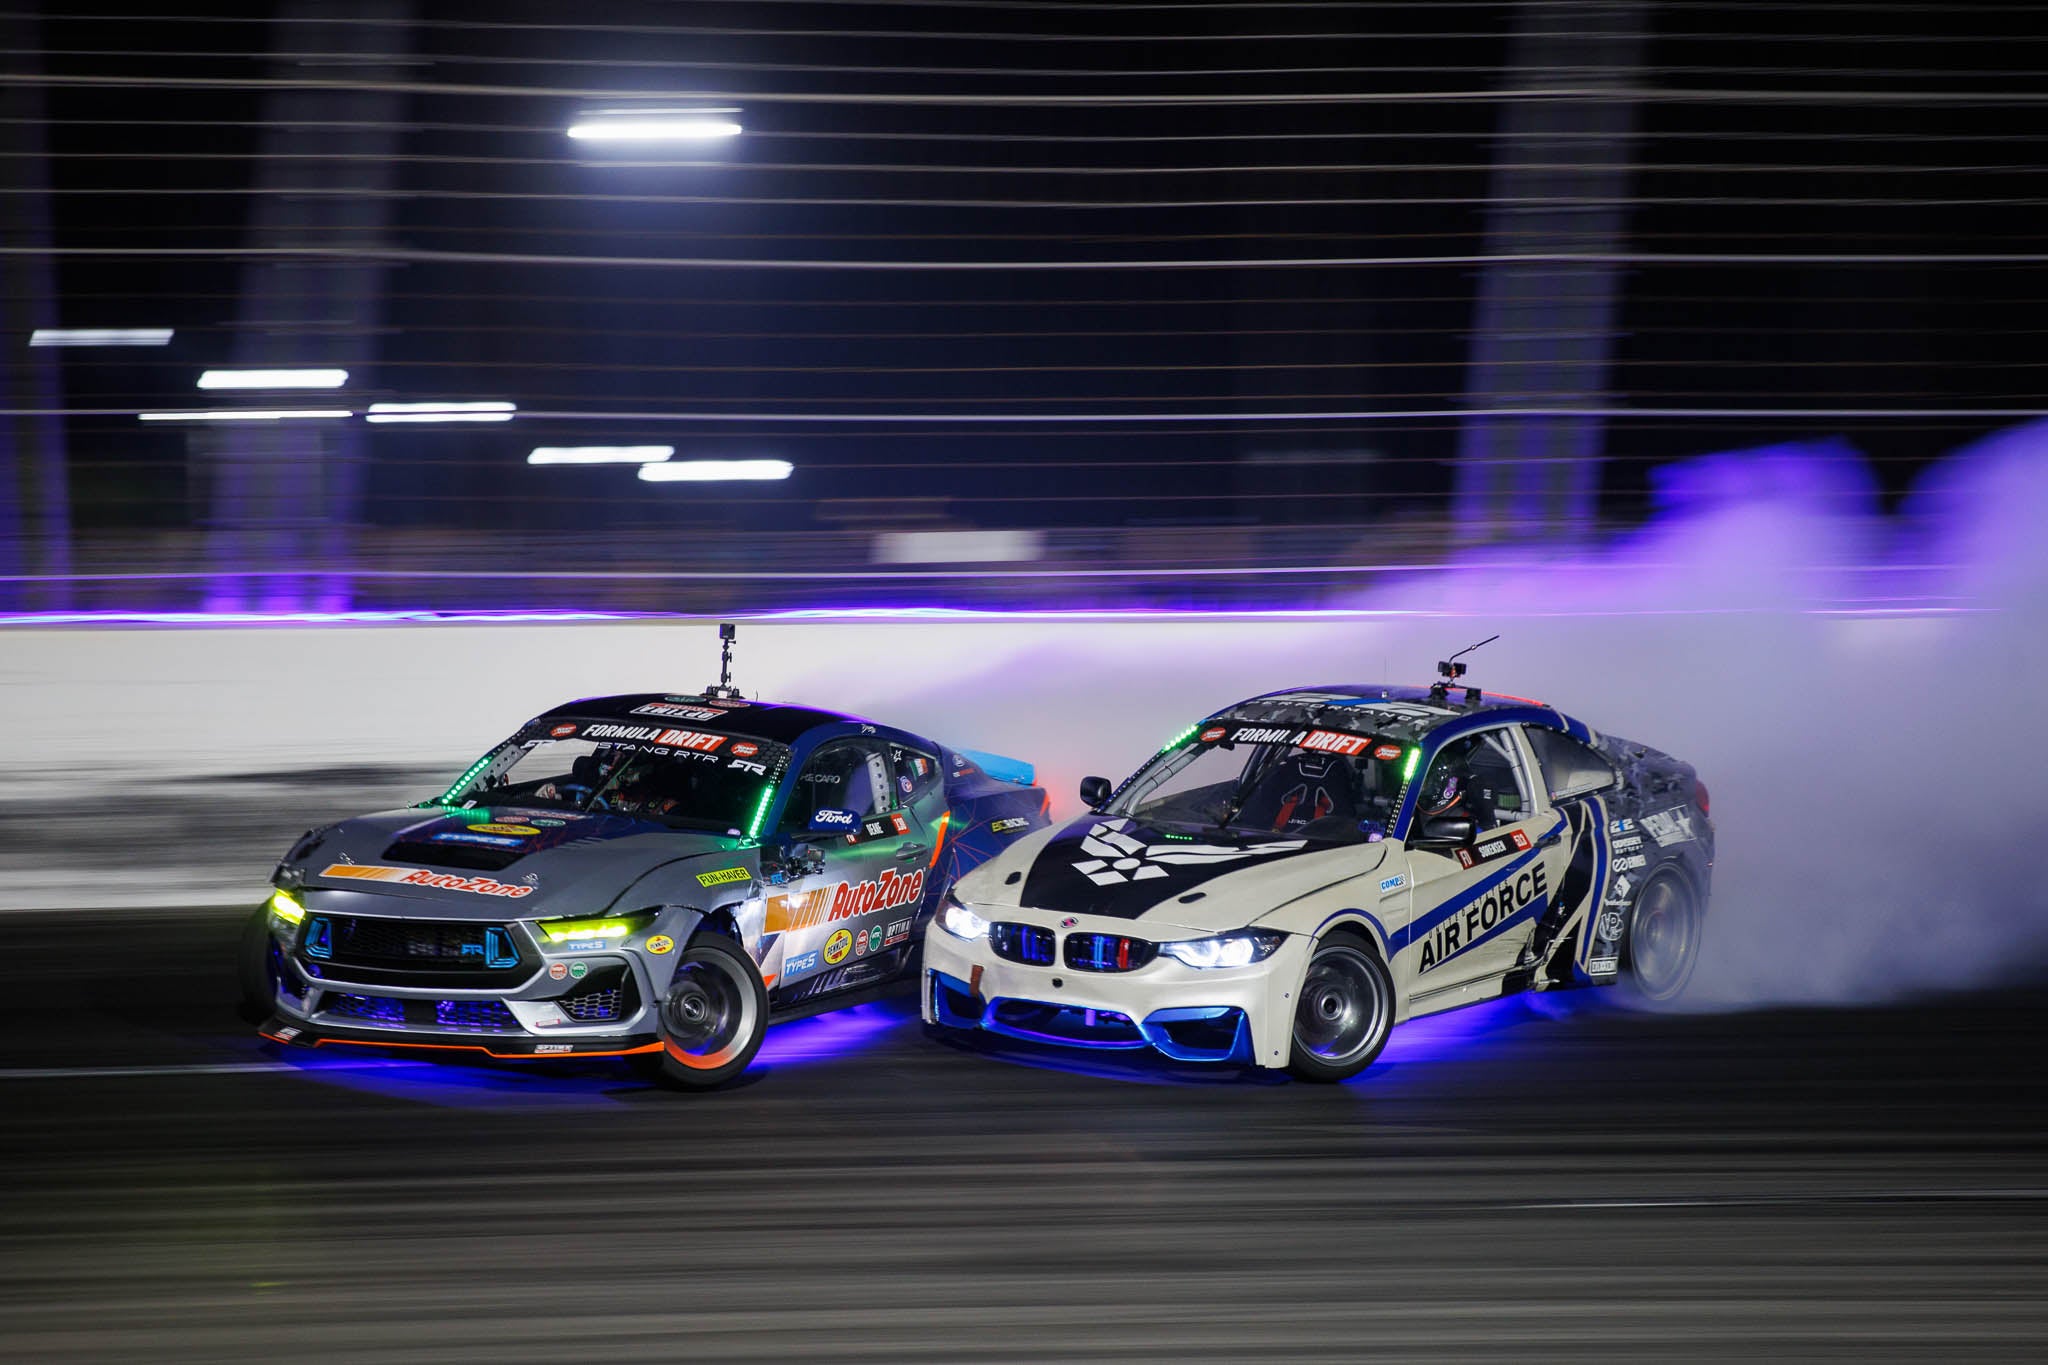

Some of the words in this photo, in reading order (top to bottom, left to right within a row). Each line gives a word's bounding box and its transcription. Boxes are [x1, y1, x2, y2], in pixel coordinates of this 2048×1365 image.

[639, 706, 714, 719] OPTIMA
[582, 724, 659, 742] FORMULA
[661, 729, 722, 750] DRIFT
[1308, 731, 1368, 754] DRIFT
[673, 751, 719, 763] RTR
[815, 810, 853, 825] Ford
[1459, 850, 1472, 867] FD
[402, 869, 532, 897] AutoZone
[700, 868, 749, 885] FUN-HAVER
[827, 868, 923, 922] AutoZone
[1419, 921, 1461, 974] AIR
[1466, 861, 1548, 942] FORCE
